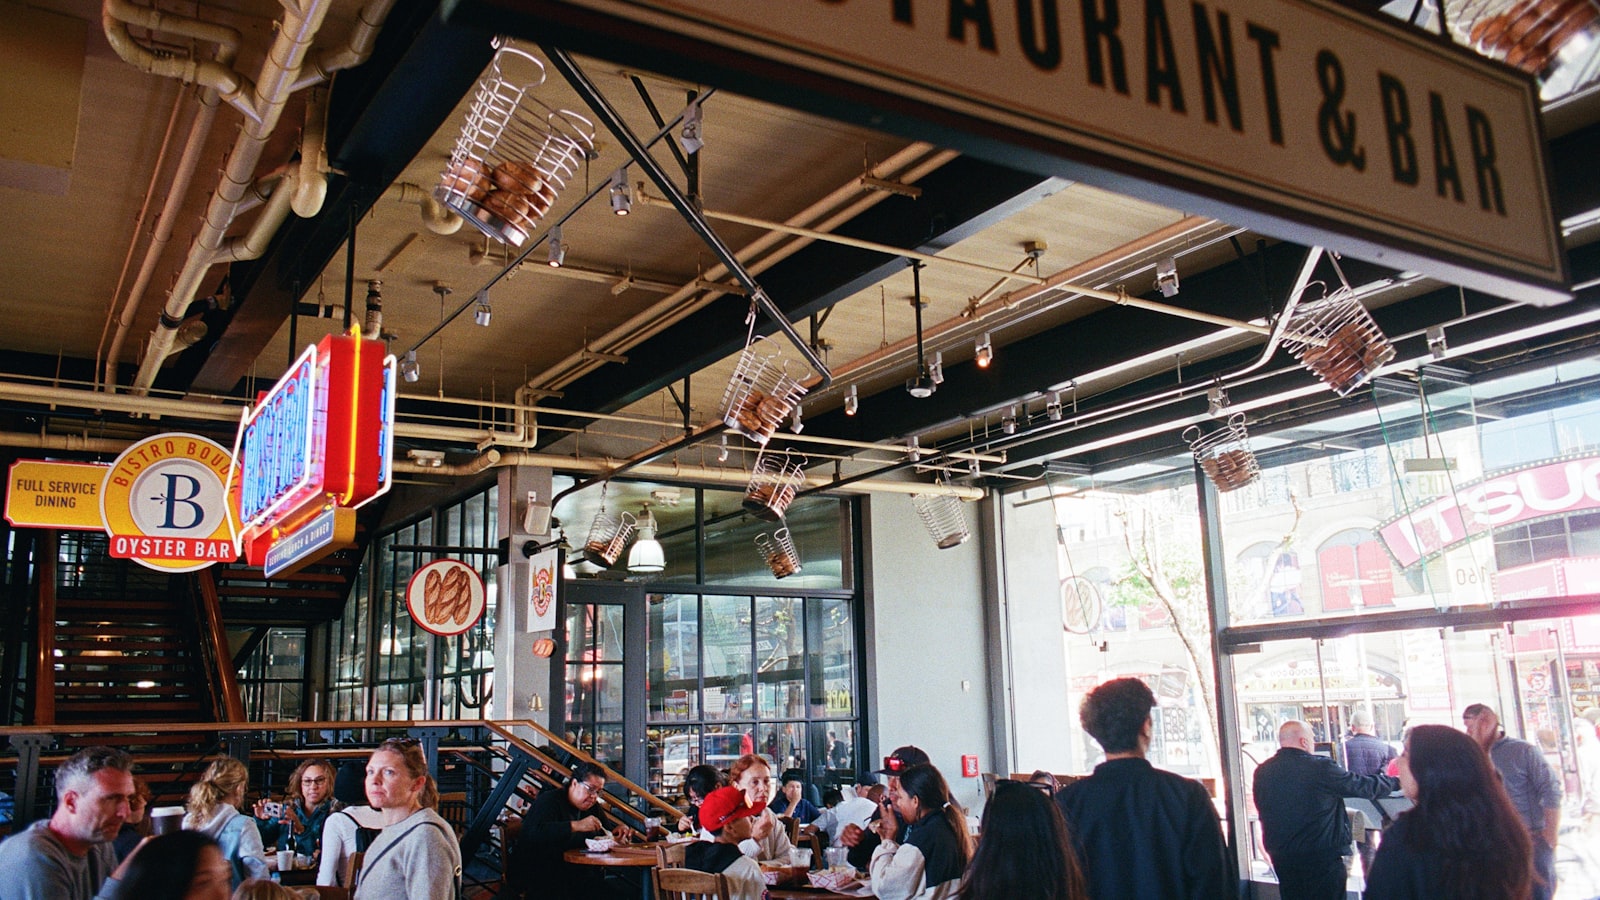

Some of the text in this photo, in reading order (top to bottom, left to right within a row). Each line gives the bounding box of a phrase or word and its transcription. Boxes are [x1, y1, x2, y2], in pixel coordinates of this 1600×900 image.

[1316, 49, 1366, 172] &
[1378, 70, 1507, 217] BAR
[113, 440, 239, 493] BISTRO BOUD
[16, 479, 97, 495] FULL SERVICE
[1418, 474, 1446, 495] EXIT
[35, 495, 76, 508] DINING
[159, 473, 205, 530] B
[116, 538, 230, 559] OYSTER BAR
